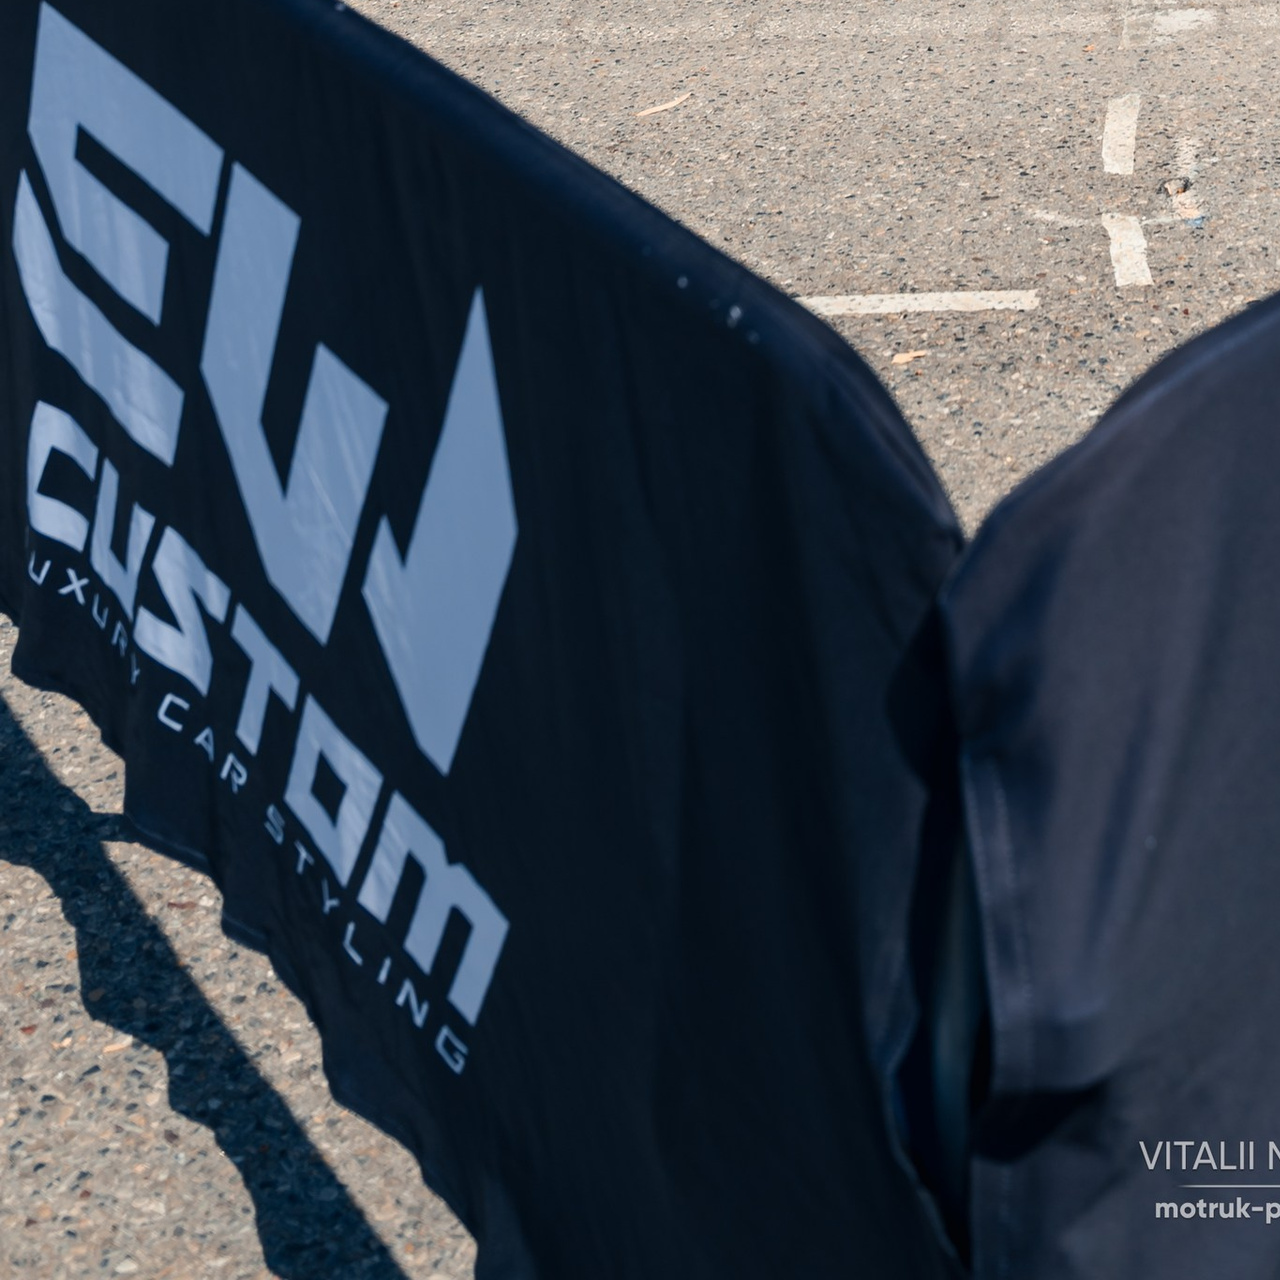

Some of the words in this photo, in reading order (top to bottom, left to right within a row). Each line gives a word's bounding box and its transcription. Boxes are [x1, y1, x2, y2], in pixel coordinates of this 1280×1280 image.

[27, 400, 510, 1027] CUSTOM
[27, 550, 141, 686] UXURY
[157, 692, 248, 794] CAR
[264, 803, 468, 1075] STYLING
